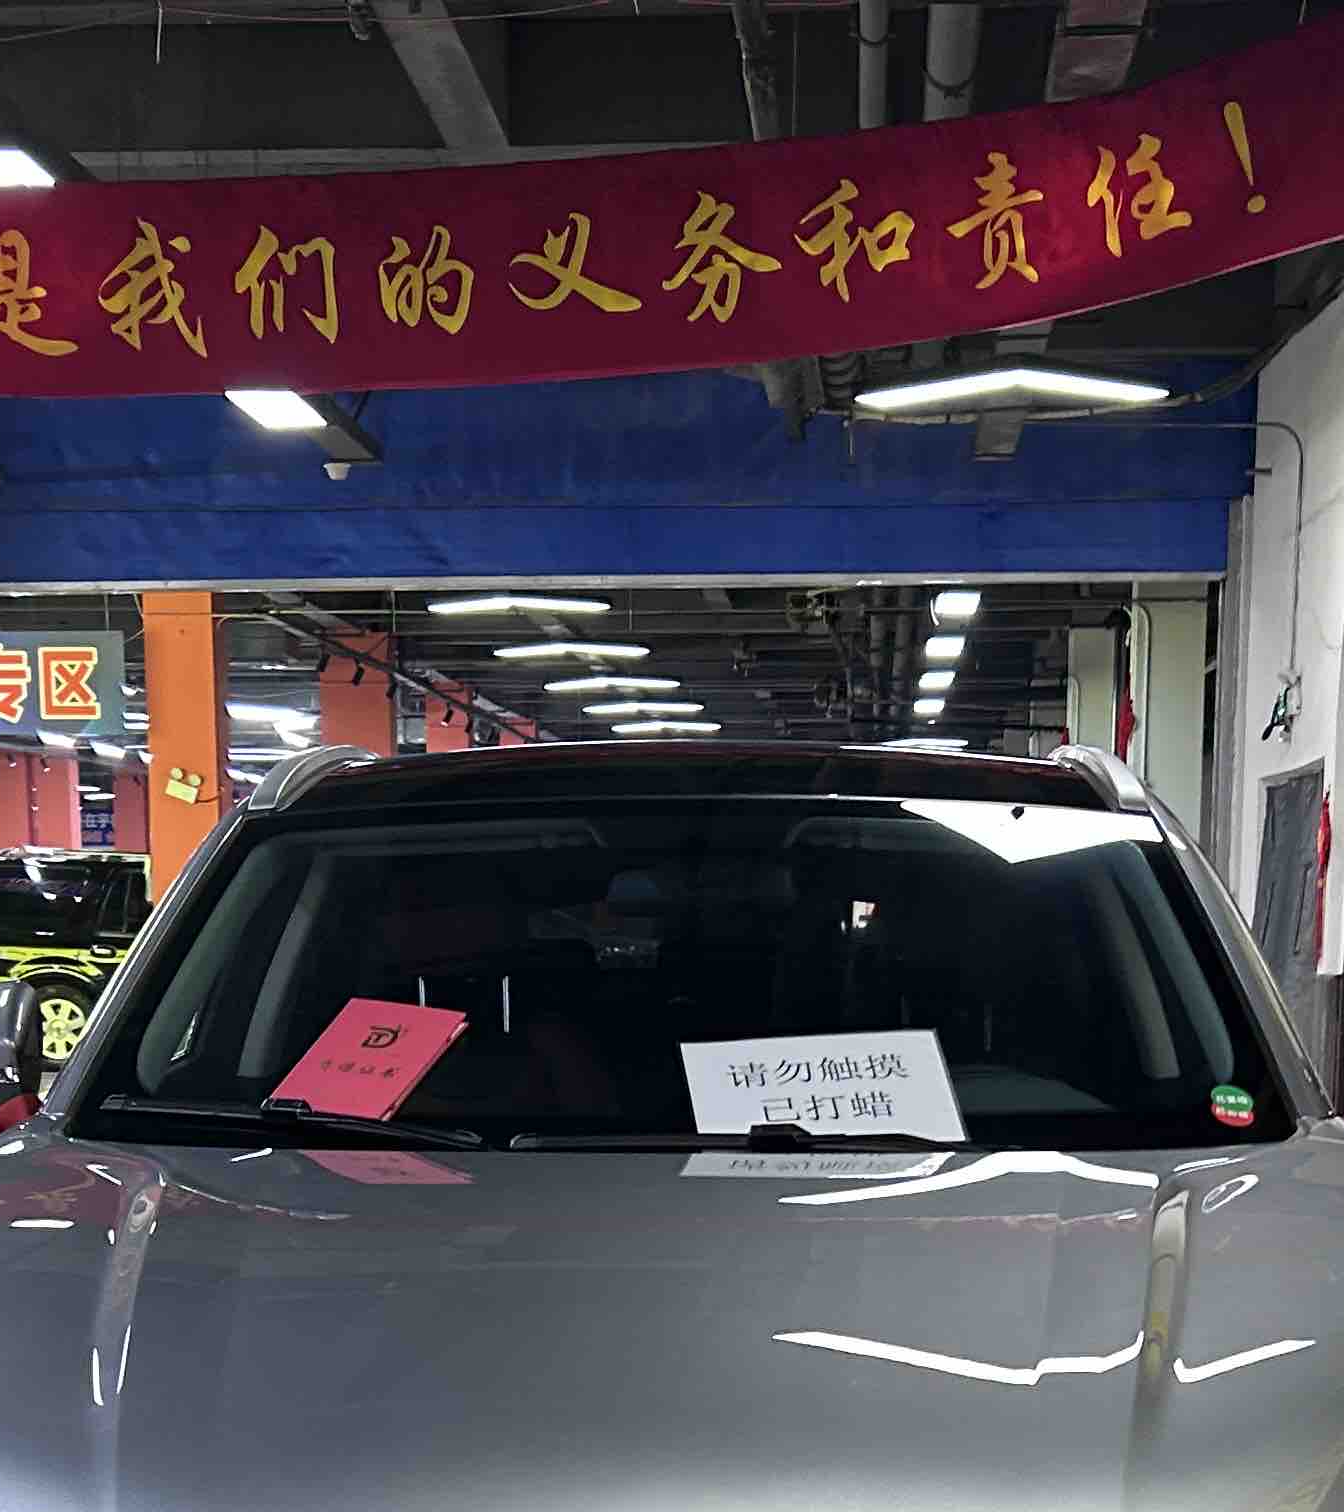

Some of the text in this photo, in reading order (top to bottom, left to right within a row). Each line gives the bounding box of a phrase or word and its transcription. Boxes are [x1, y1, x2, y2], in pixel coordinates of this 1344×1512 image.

[726, 1053, 909, 1088] 请勿触摸
[760, 1091, 893, 1121] 已打蜡
